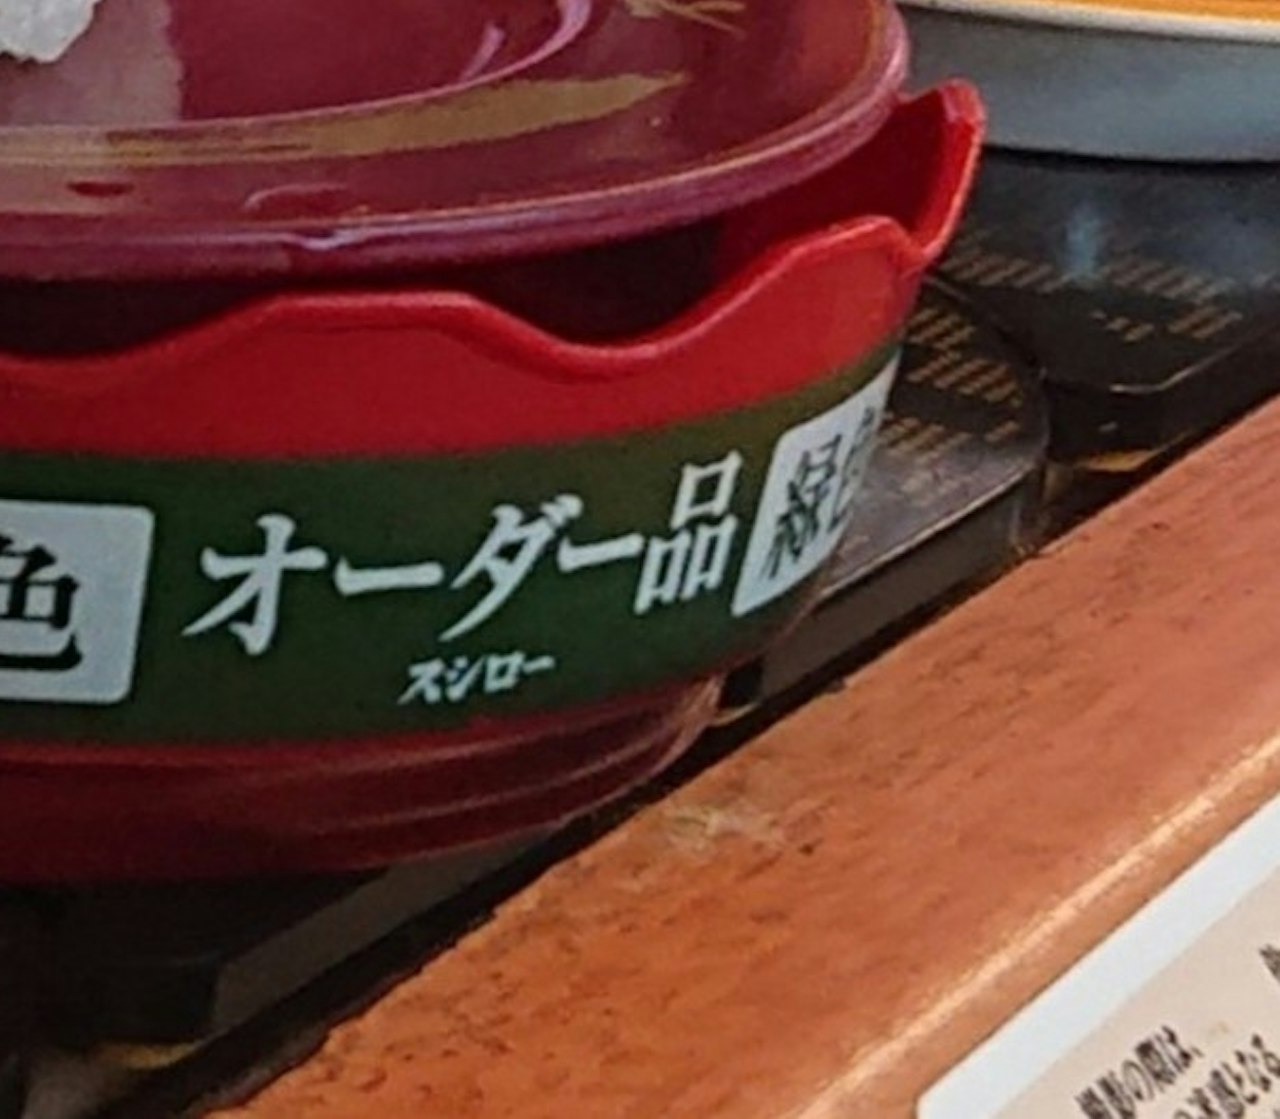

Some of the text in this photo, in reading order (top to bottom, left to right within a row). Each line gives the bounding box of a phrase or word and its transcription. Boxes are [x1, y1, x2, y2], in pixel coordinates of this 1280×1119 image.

[182, 450, 742, 656] オーダー品
[396, 651, 556, 706] スシロー
